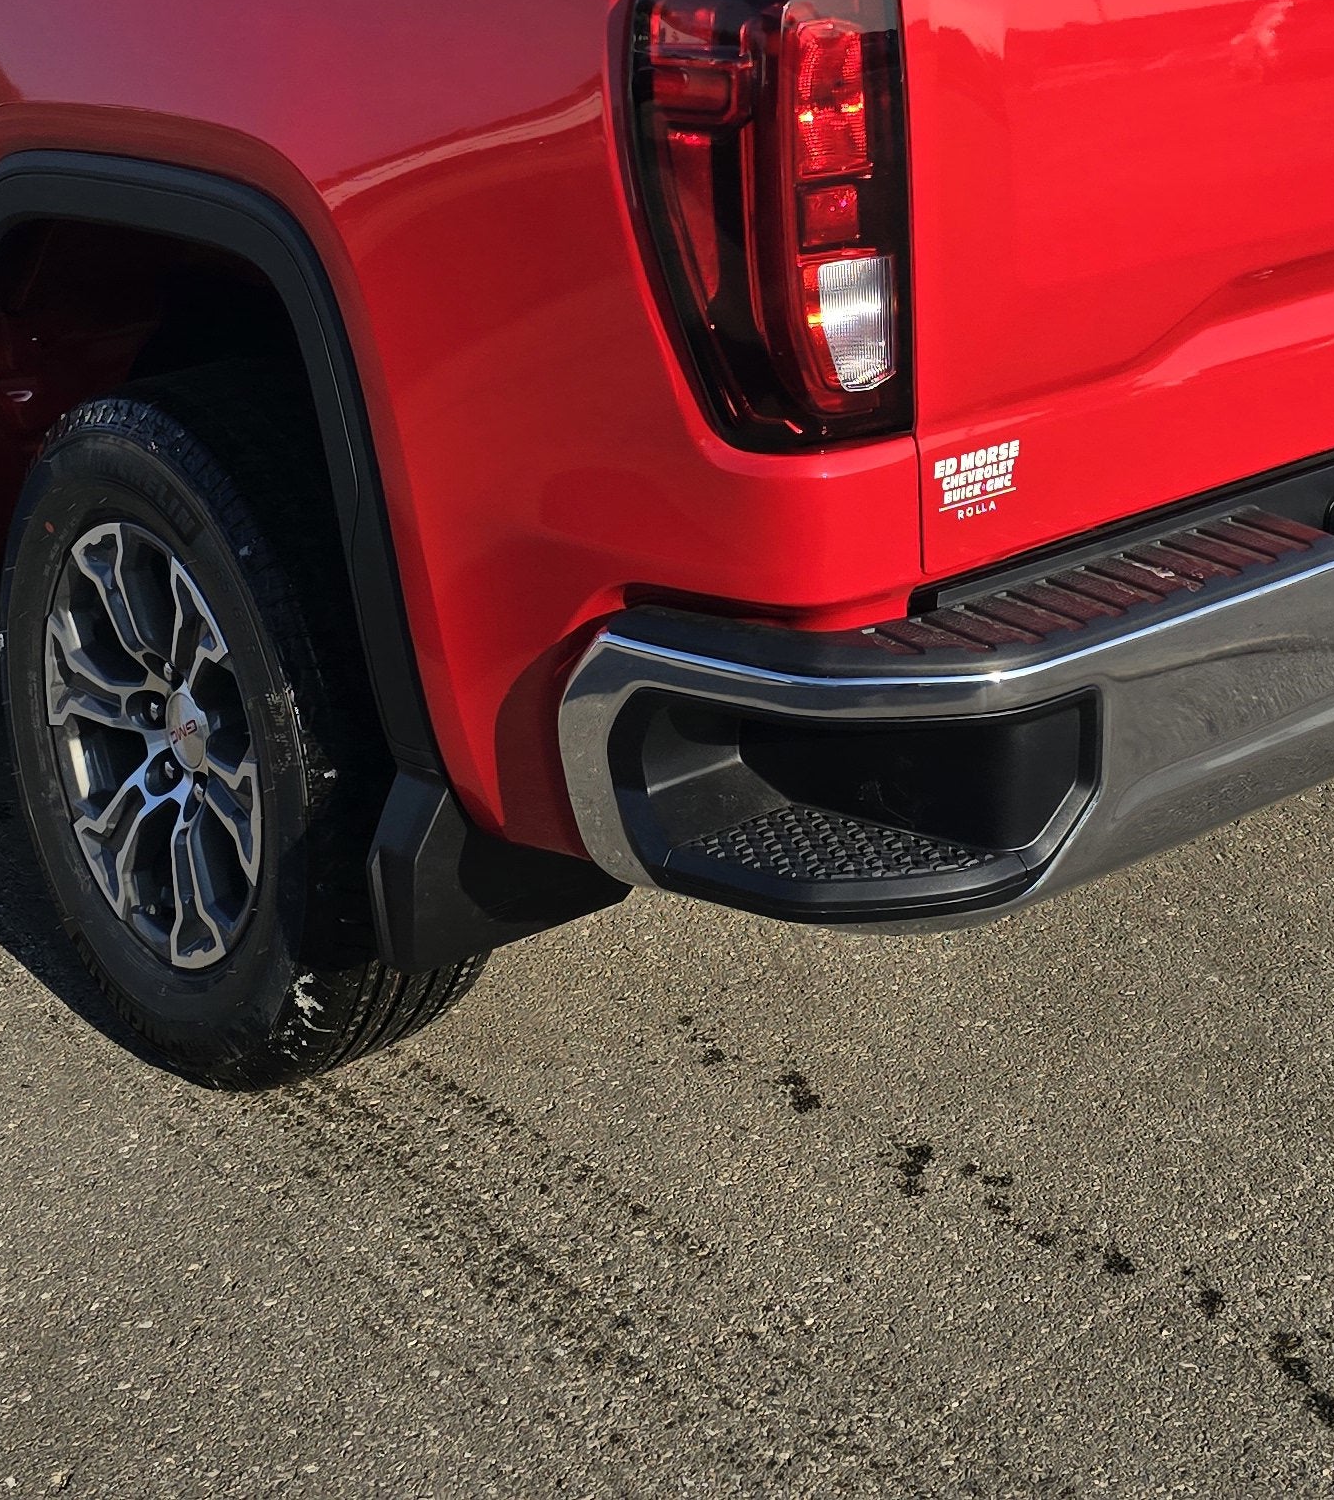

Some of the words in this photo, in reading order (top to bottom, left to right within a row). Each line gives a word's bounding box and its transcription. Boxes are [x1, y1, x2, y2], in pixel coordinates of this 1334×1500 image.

[934, 457, 958, 479] ED
[960, 440, 1019, 472] MORSE
[942, 459, 1015, 491] CHEVROLET
[957, 501, 997, 520] ROLLA
[170, 719, 198, 745] GMC
